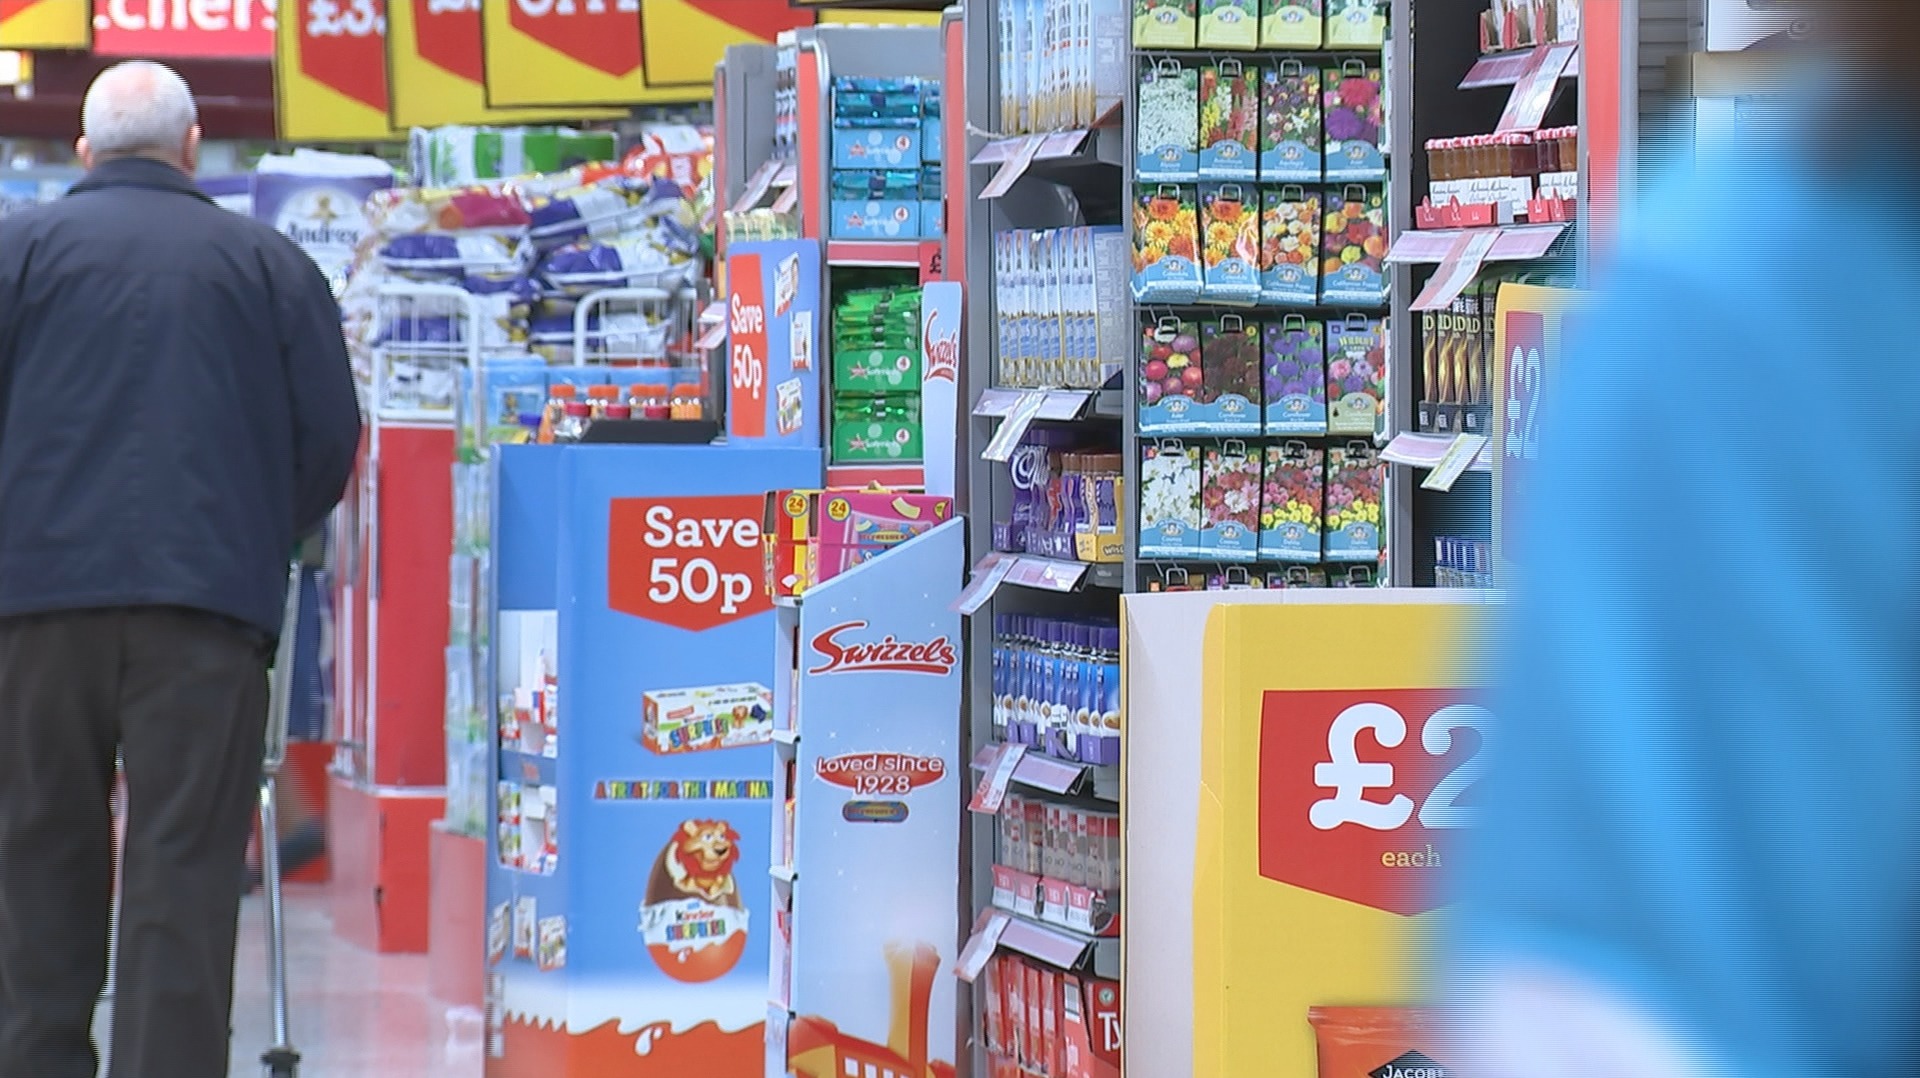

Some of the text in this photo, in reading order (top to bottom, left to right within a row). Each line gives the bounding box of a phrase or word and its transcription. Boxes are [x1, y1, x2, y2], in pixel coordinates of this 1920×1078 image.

[731, 293, 763, 334] Save
[732, 345, 762, 399] 50p
[789, 498, 803, 510] 24
[831, 502, 846, 513] 24
[644, 505, 760, 548] Save
[648, 557, 753, 614] 50p
[809, 621, 957, 675] Swizzels
[816, 753, 943, 774] Loved since
[855, 774, 911, 794] 1928
[1308, 701, 1498, 831] £2
[1382, 845, 1442, 868] each
